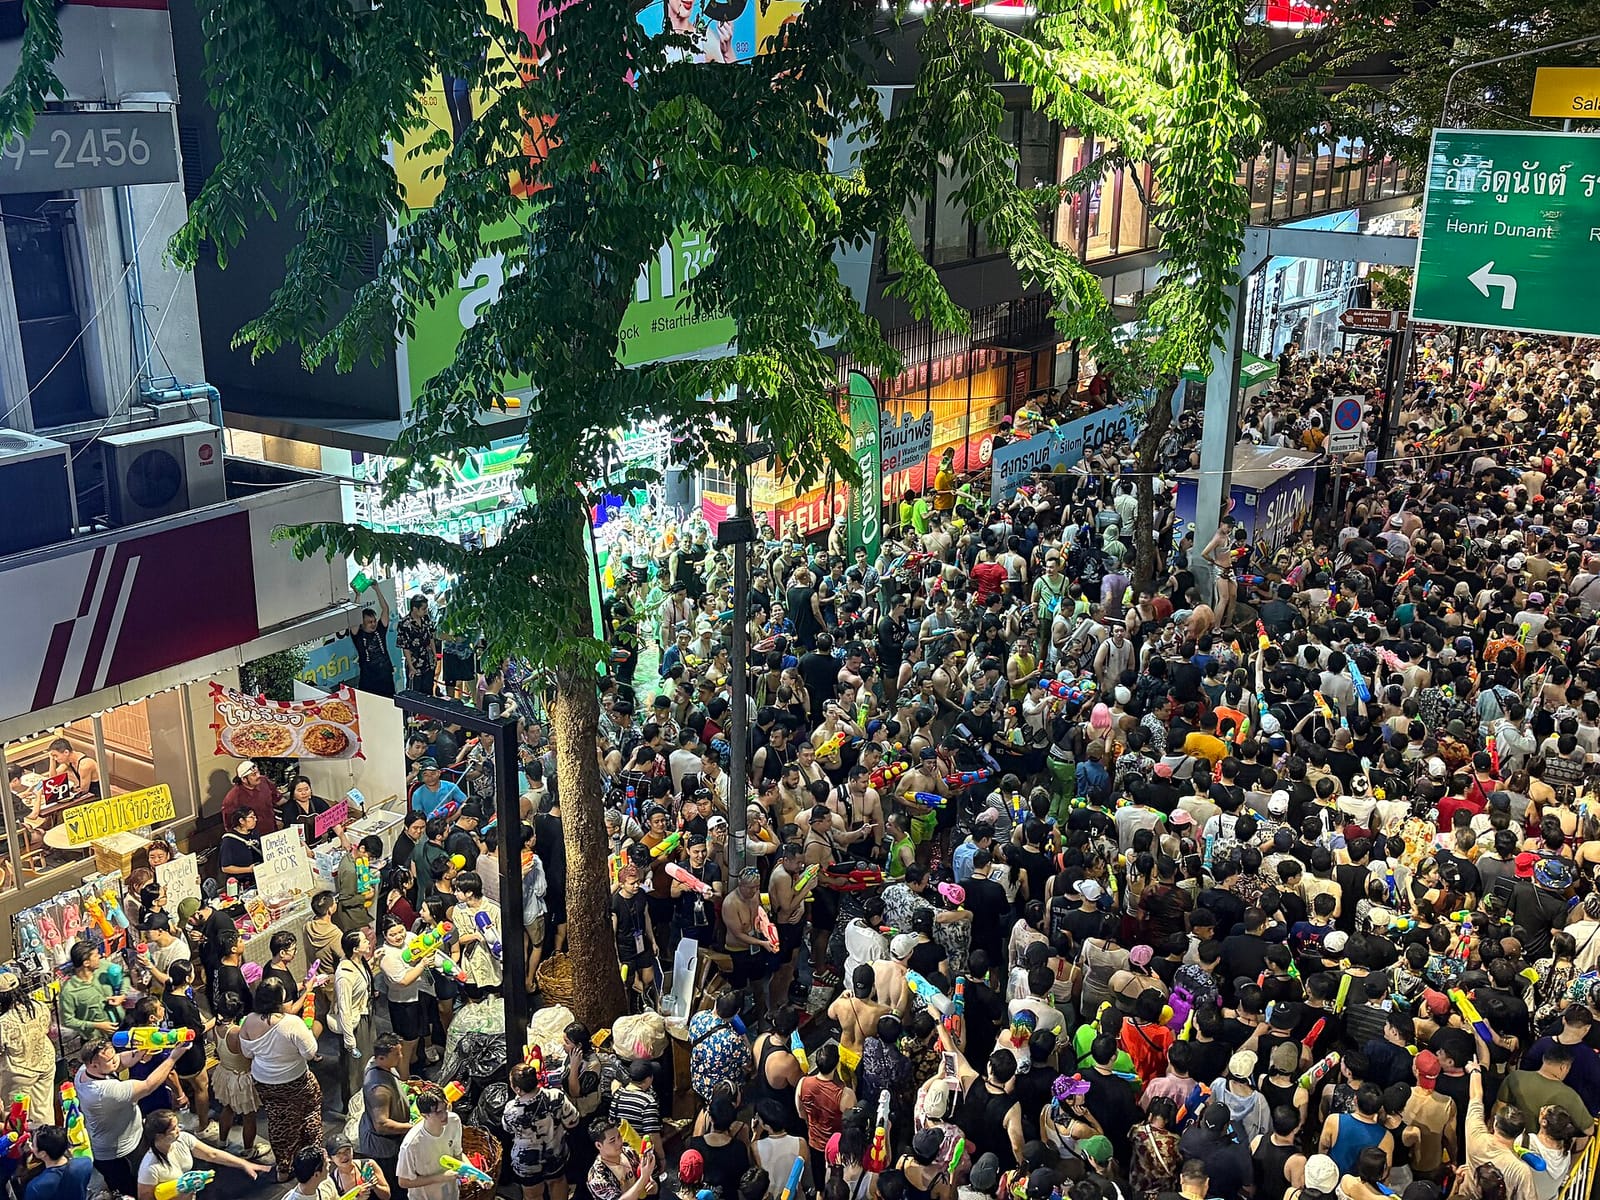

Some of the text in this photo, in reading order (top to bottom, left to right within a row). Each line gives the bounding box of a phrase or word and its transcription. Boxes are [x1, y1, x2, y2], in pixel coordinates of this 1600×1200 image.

[1572, 96, 1600, 111] Sal
[1446, 218, 1489, 235] Henri
[1494, 221, 1553, 239] Dunant
[882, 414, 932, 451] ติมน้ำฟรี
[1059, 437, 1082, 454] Silom
[859, 450, 878, 545] Chang
